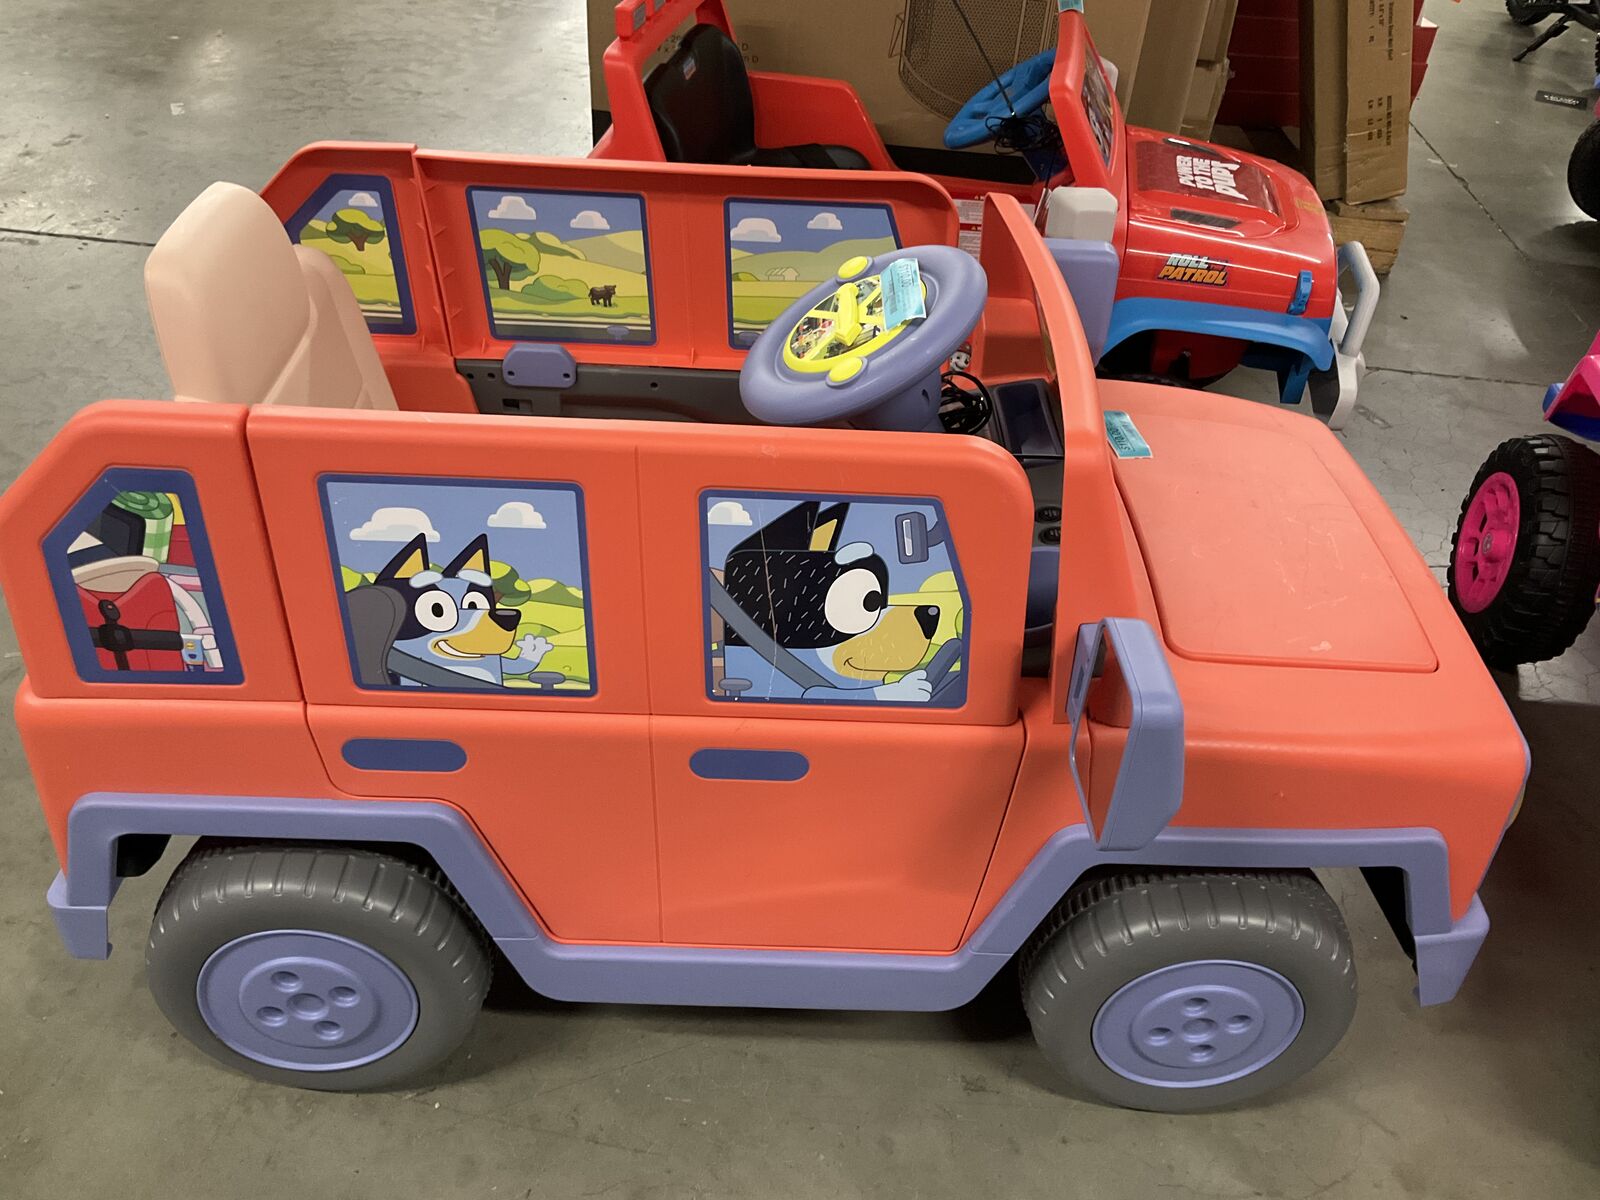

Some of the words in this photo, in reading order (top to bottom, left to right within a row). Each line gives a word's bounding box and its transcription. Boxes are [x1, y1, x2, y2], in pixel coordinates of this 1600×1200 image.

[1176, 155, 1197, 188] POWER
[1192, 157, 1211, 176] THE
[1194, 175, 1215, 191] TO
[1166, 253, 1209, 269] ROLL
[1158, 265, 1227, 285] PATROL
